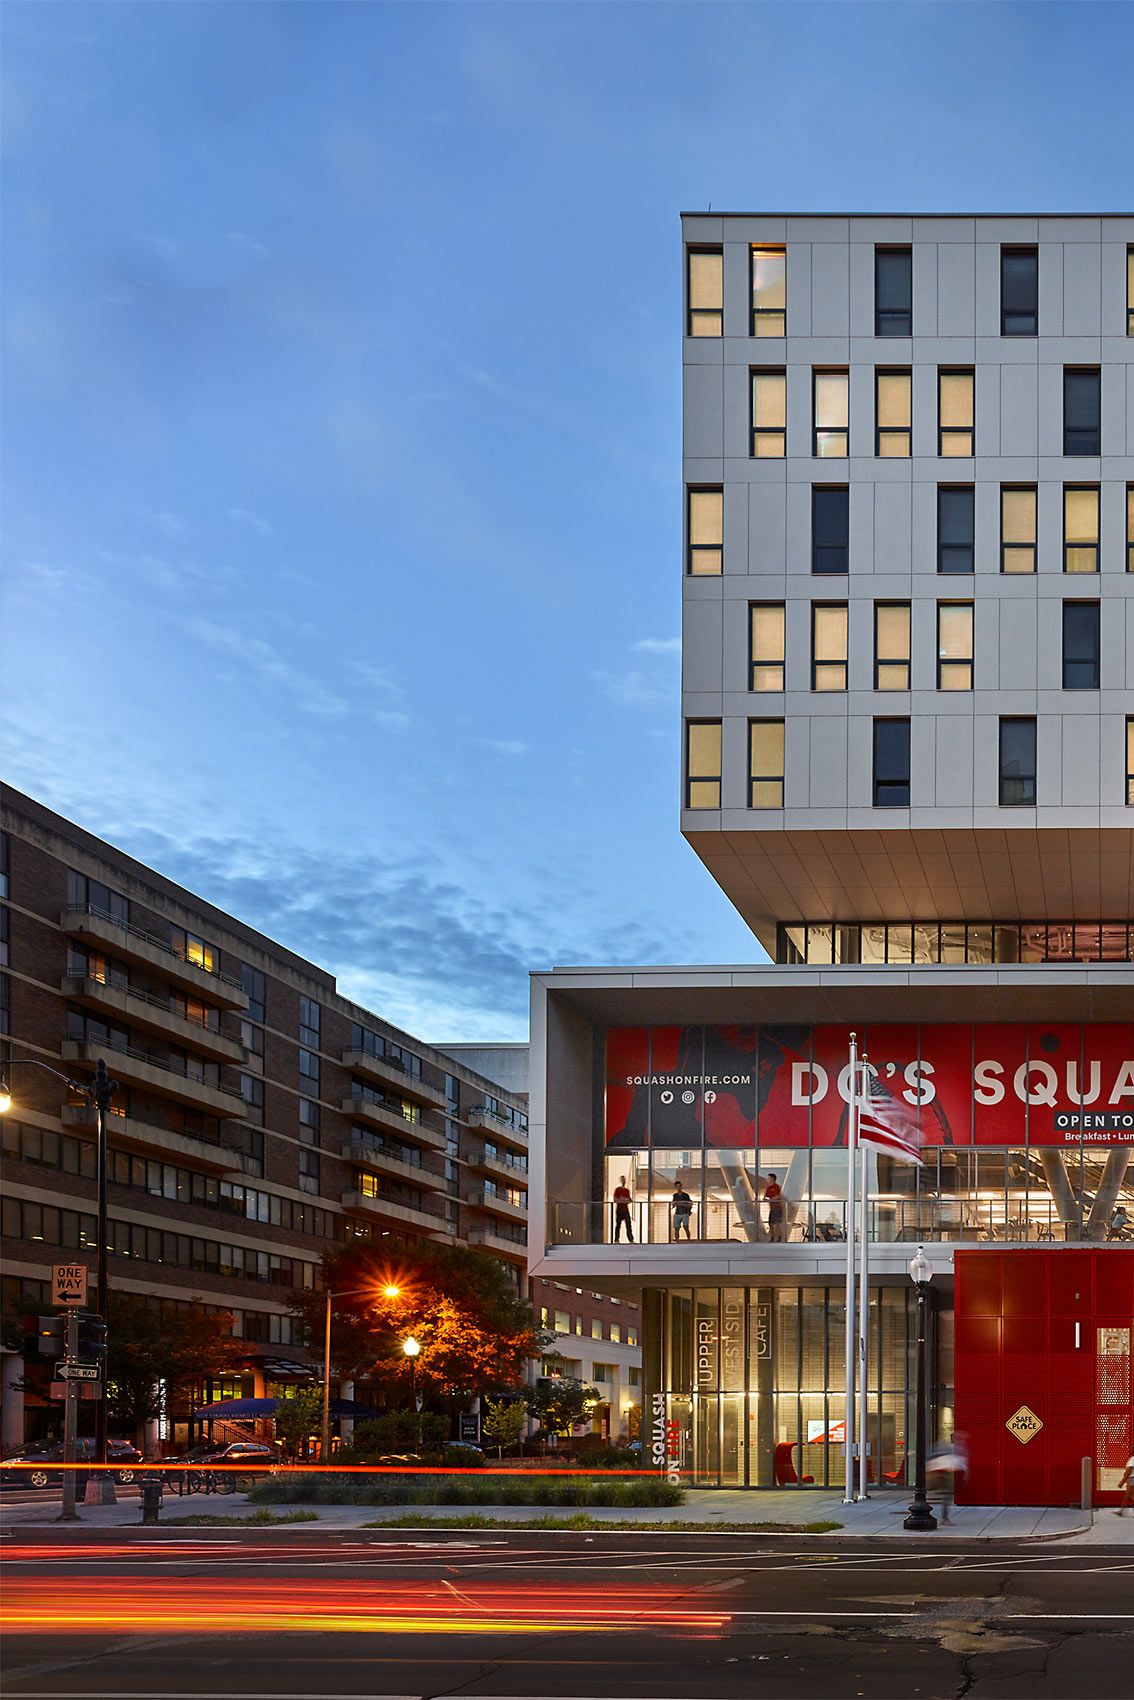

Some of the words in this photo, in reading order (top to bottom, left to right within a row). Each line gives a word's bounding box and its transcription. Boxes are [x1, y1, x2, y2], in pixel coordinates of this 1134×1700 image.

[626, 1075, 751, 1085] SQUASHONFIRE.COM
[1057, 1115, 1105, 1127] OPEN
[1111, 1115, 1134, 1127] TO
[1065, 1132, 1111, 1141] Breakfast
[58, 1268, 82, 1278] ONE
[57, 1280, 82, 1289] WAY
[699, 1320, 714, 1382] UPPER
[67, 1368, 80, 1376] ONE
[82, 1369, 96, 1377] WAY
[652, 1393, 665, 1465] SQUASH
[667, 1419, 680, 1455] FIRE
